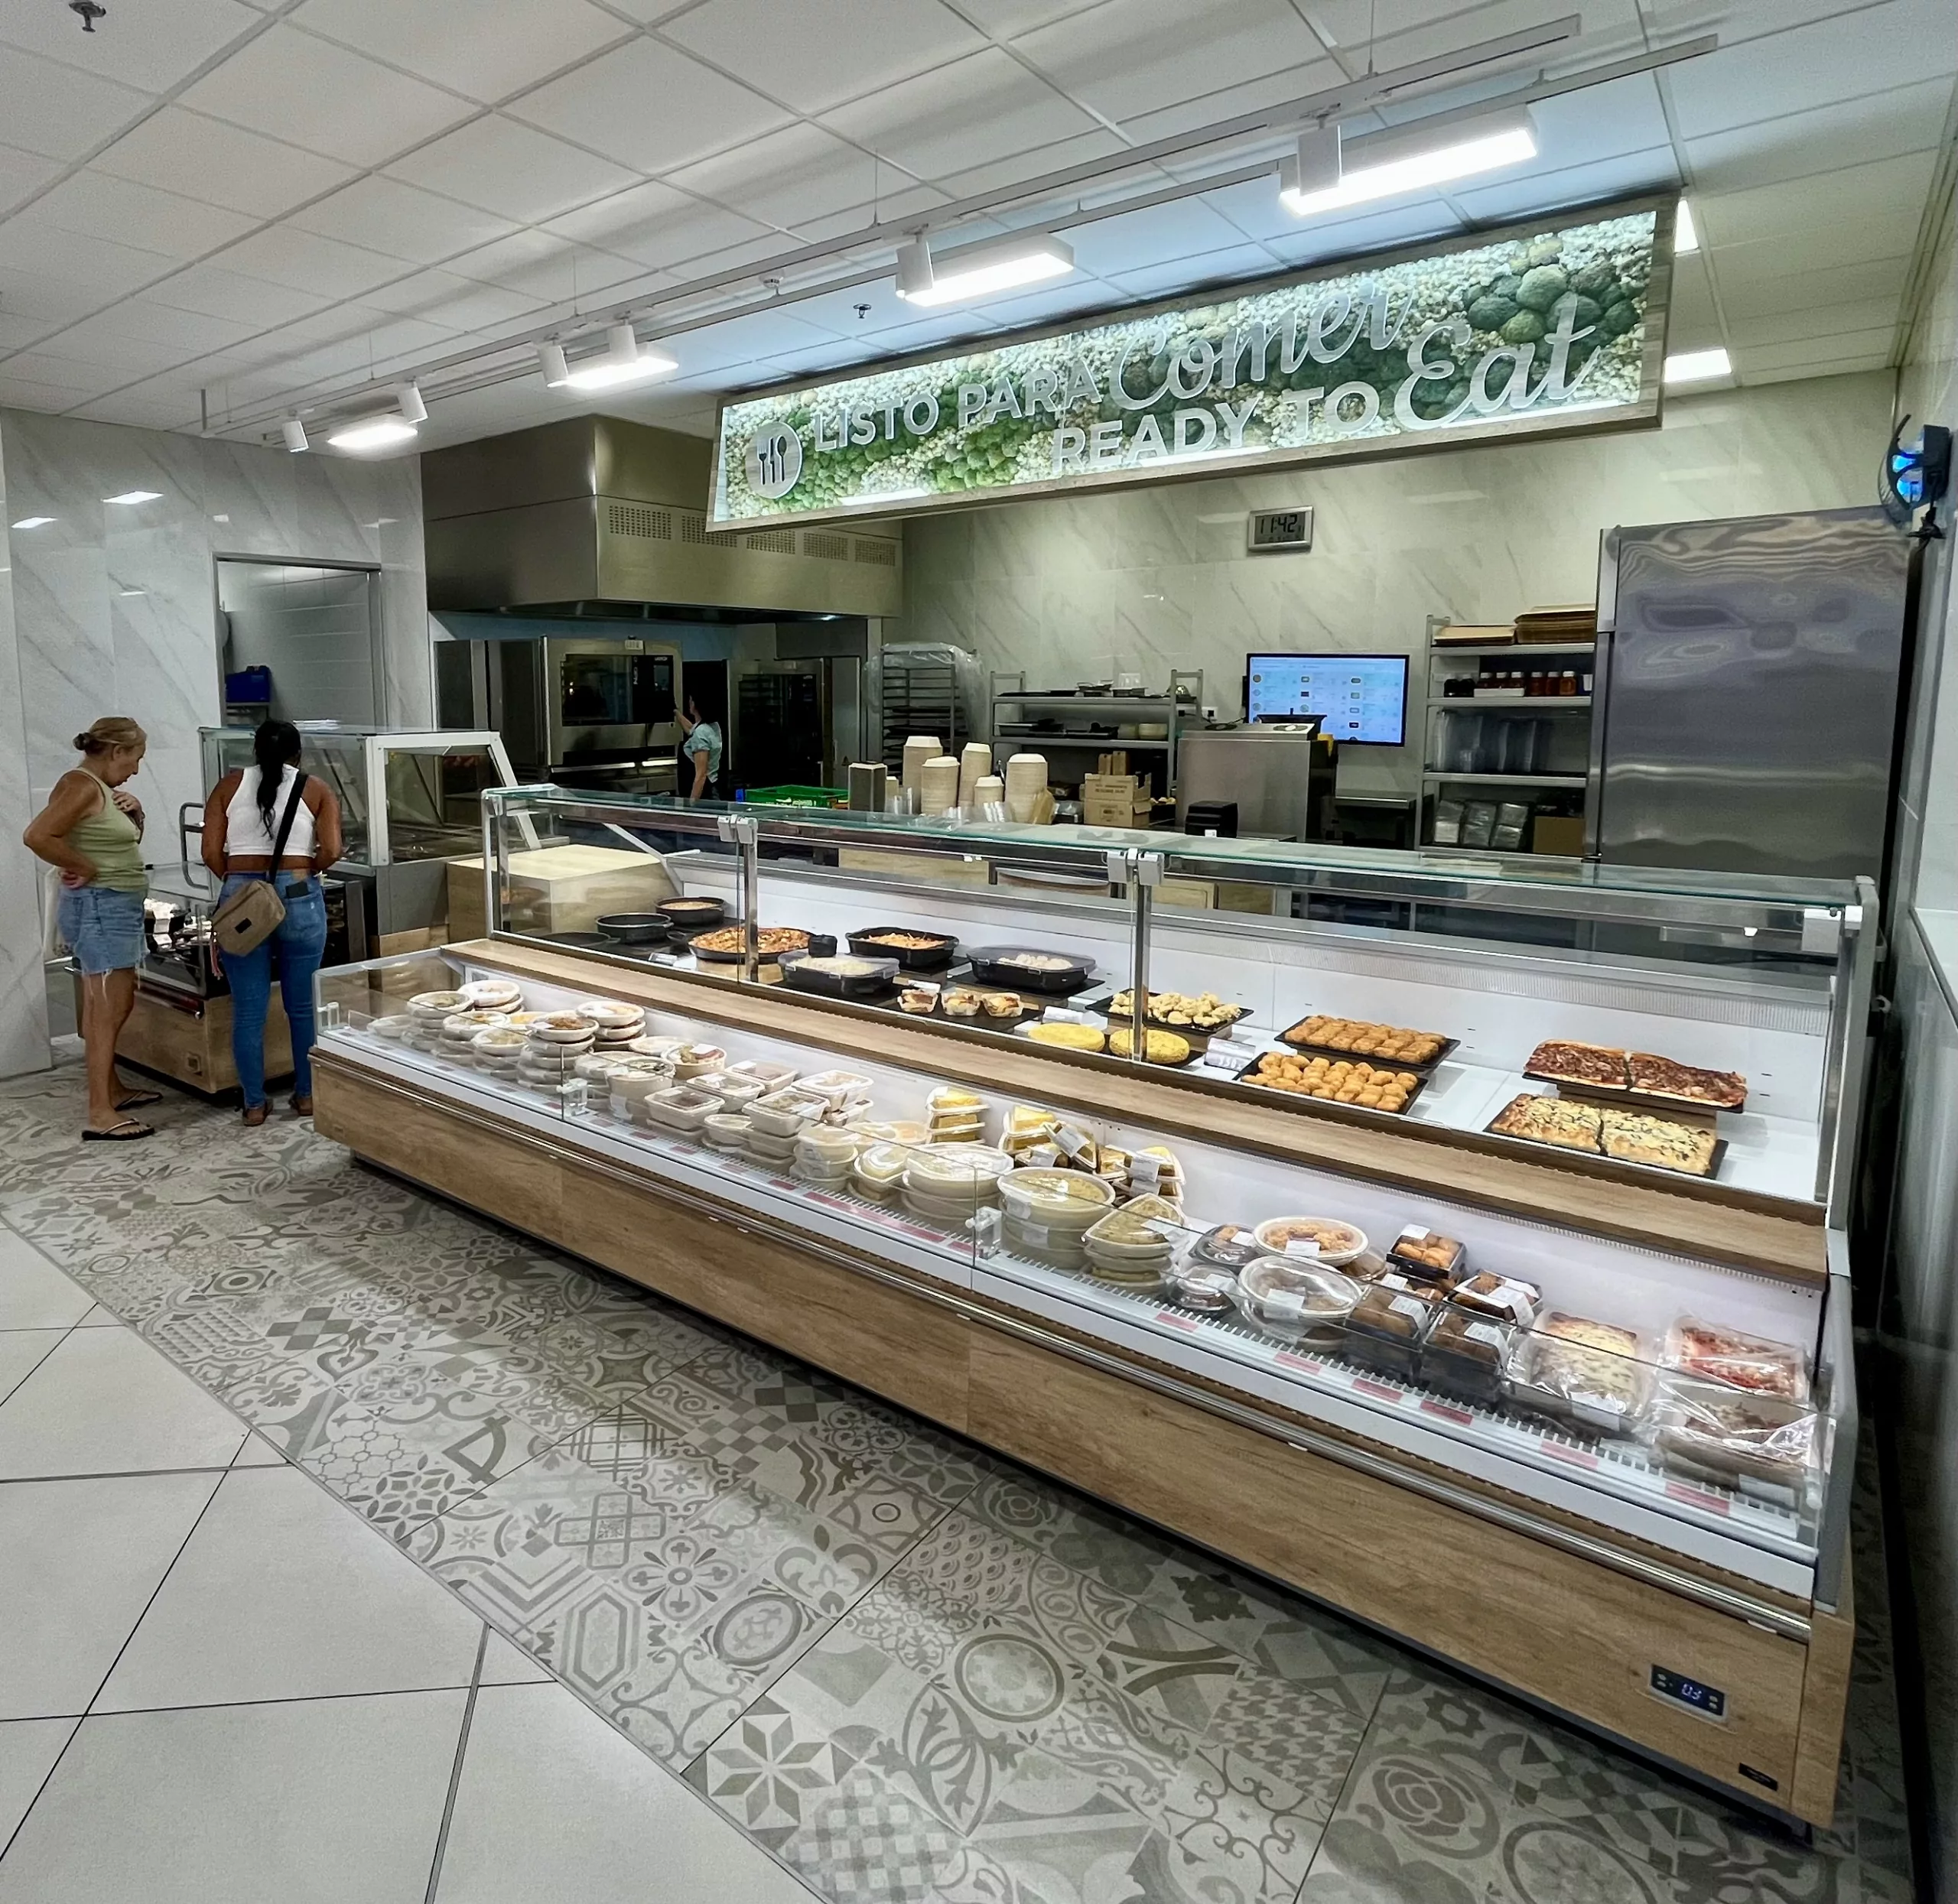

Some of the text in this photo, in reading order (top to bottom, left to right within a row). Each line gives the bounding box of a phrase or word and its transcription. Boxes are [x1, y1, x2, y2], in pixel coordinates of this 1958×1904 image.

[812, 276, 1415, 452] LISTO PARA Comer
[1051, 291, 1602, 476] READY TO Eat
[1260, 513, 1299, 534] 11:42
